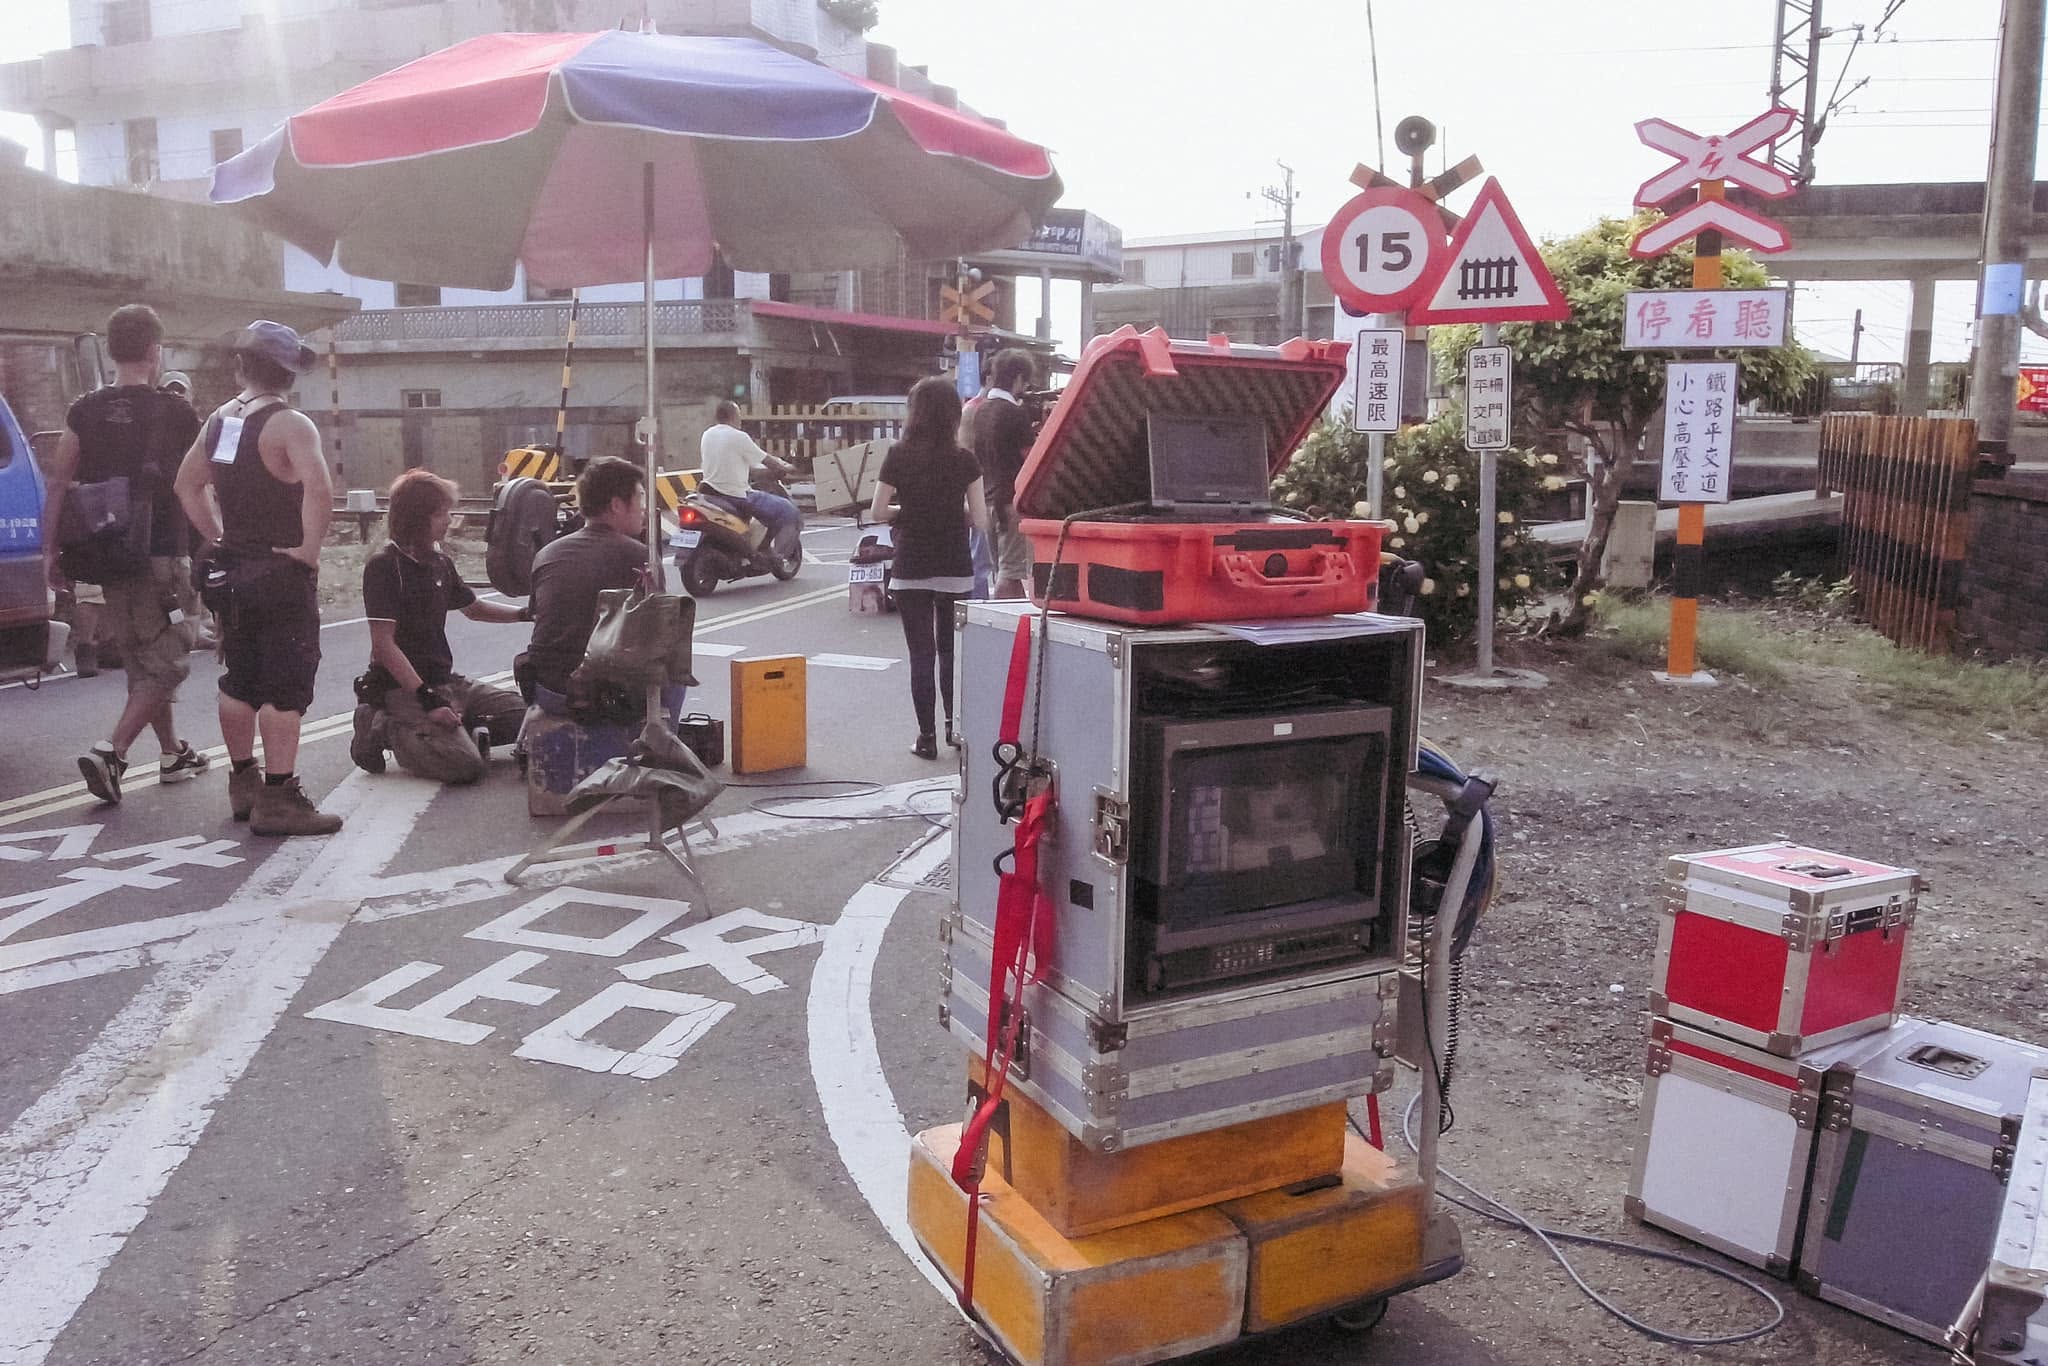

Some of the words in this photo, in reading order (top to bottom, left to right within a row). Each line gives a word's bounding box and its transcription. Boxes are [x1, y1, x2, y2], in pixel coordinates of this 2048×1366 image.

[1355, 232, 1412, 272] 15
[1637, 298, 1772, 340] 停看聽
[1367, 338, 1389, 422] 最高速限
[1473, 355, 1489, 444] 路平交道
[1701, 371, 1727, 493] 鐵路平交道
